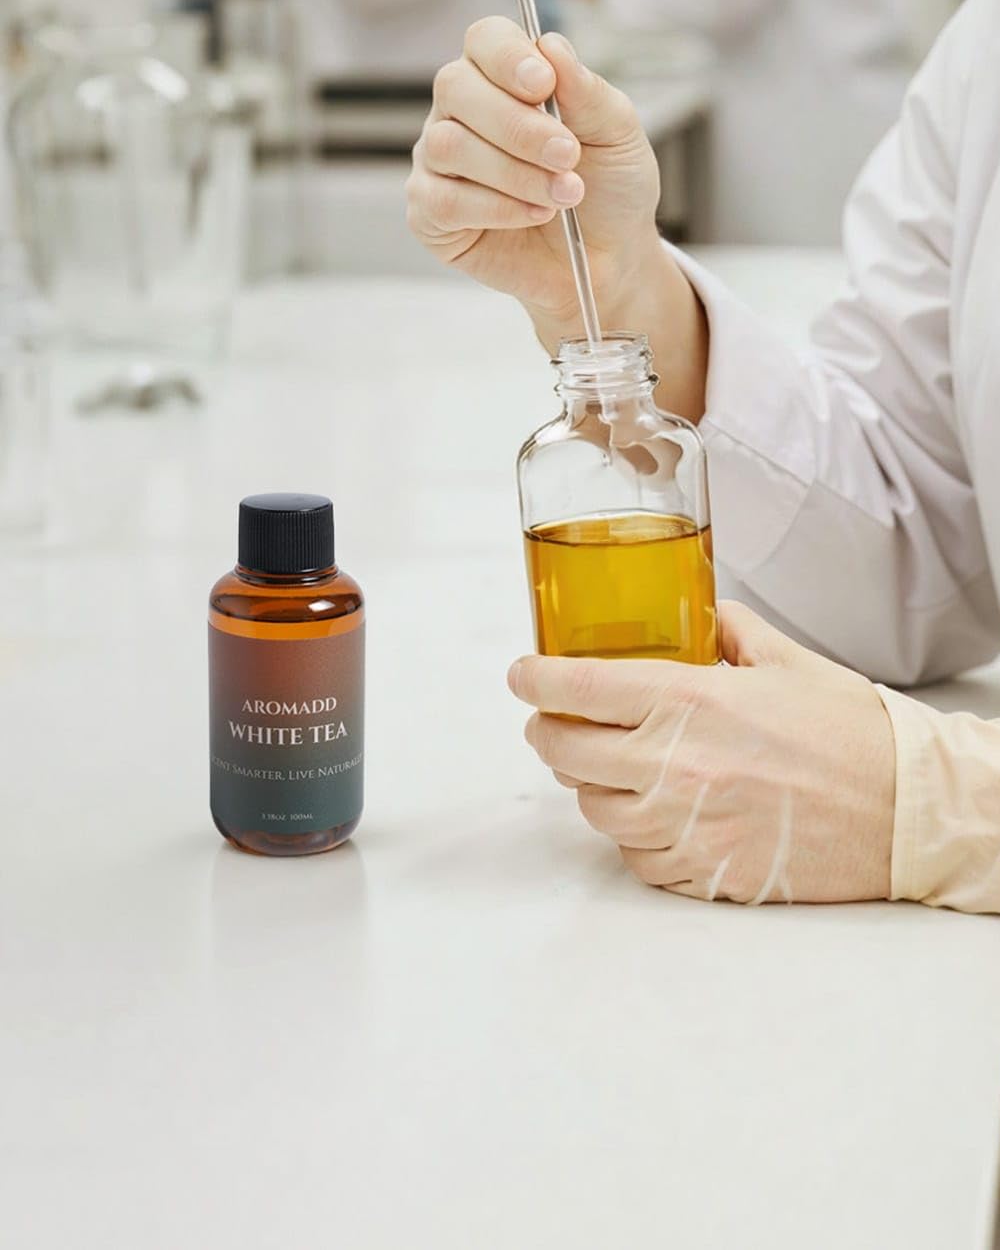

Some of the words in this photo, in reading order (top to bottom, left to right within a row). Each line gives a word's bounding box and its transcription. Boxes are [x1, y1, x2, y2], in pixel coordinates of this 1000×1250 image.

[241, 697, 337, 715] AROMADD
[228, 721, 303, 745] WHITE
[308, 721, 349, 744] TEA
[288, 769, 314, 781] LIVE
